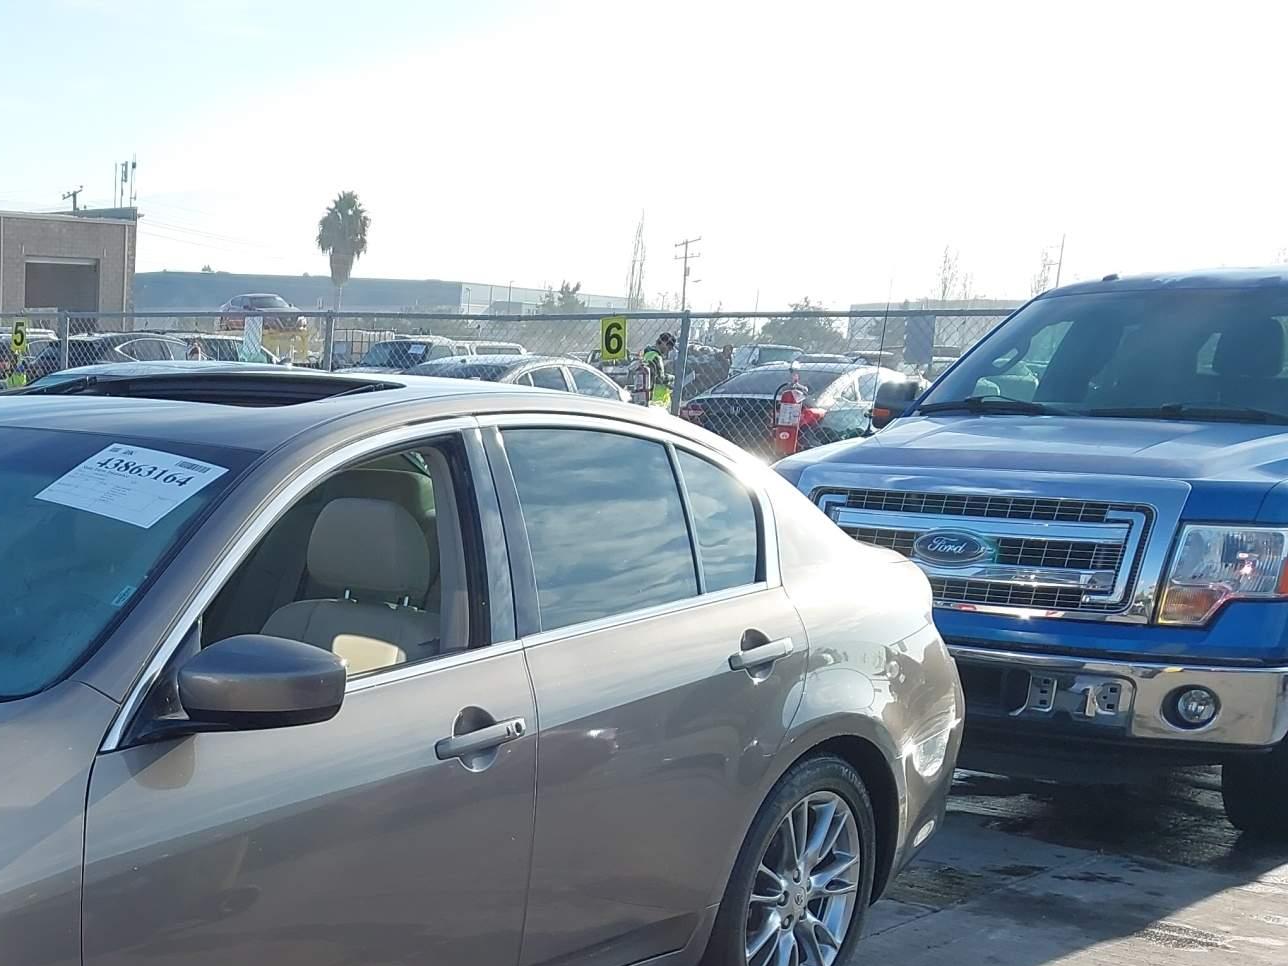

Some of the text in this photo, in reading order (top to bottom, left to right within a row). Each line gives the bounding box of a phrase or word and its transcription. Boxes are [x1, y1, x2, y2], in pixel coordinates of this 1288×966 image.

[14, 321, 24, 346] 5
[605, 322, 623, 354] 6
[97, 457, 194, 487] 43863164
[928, 536, 967, 553] Ford
